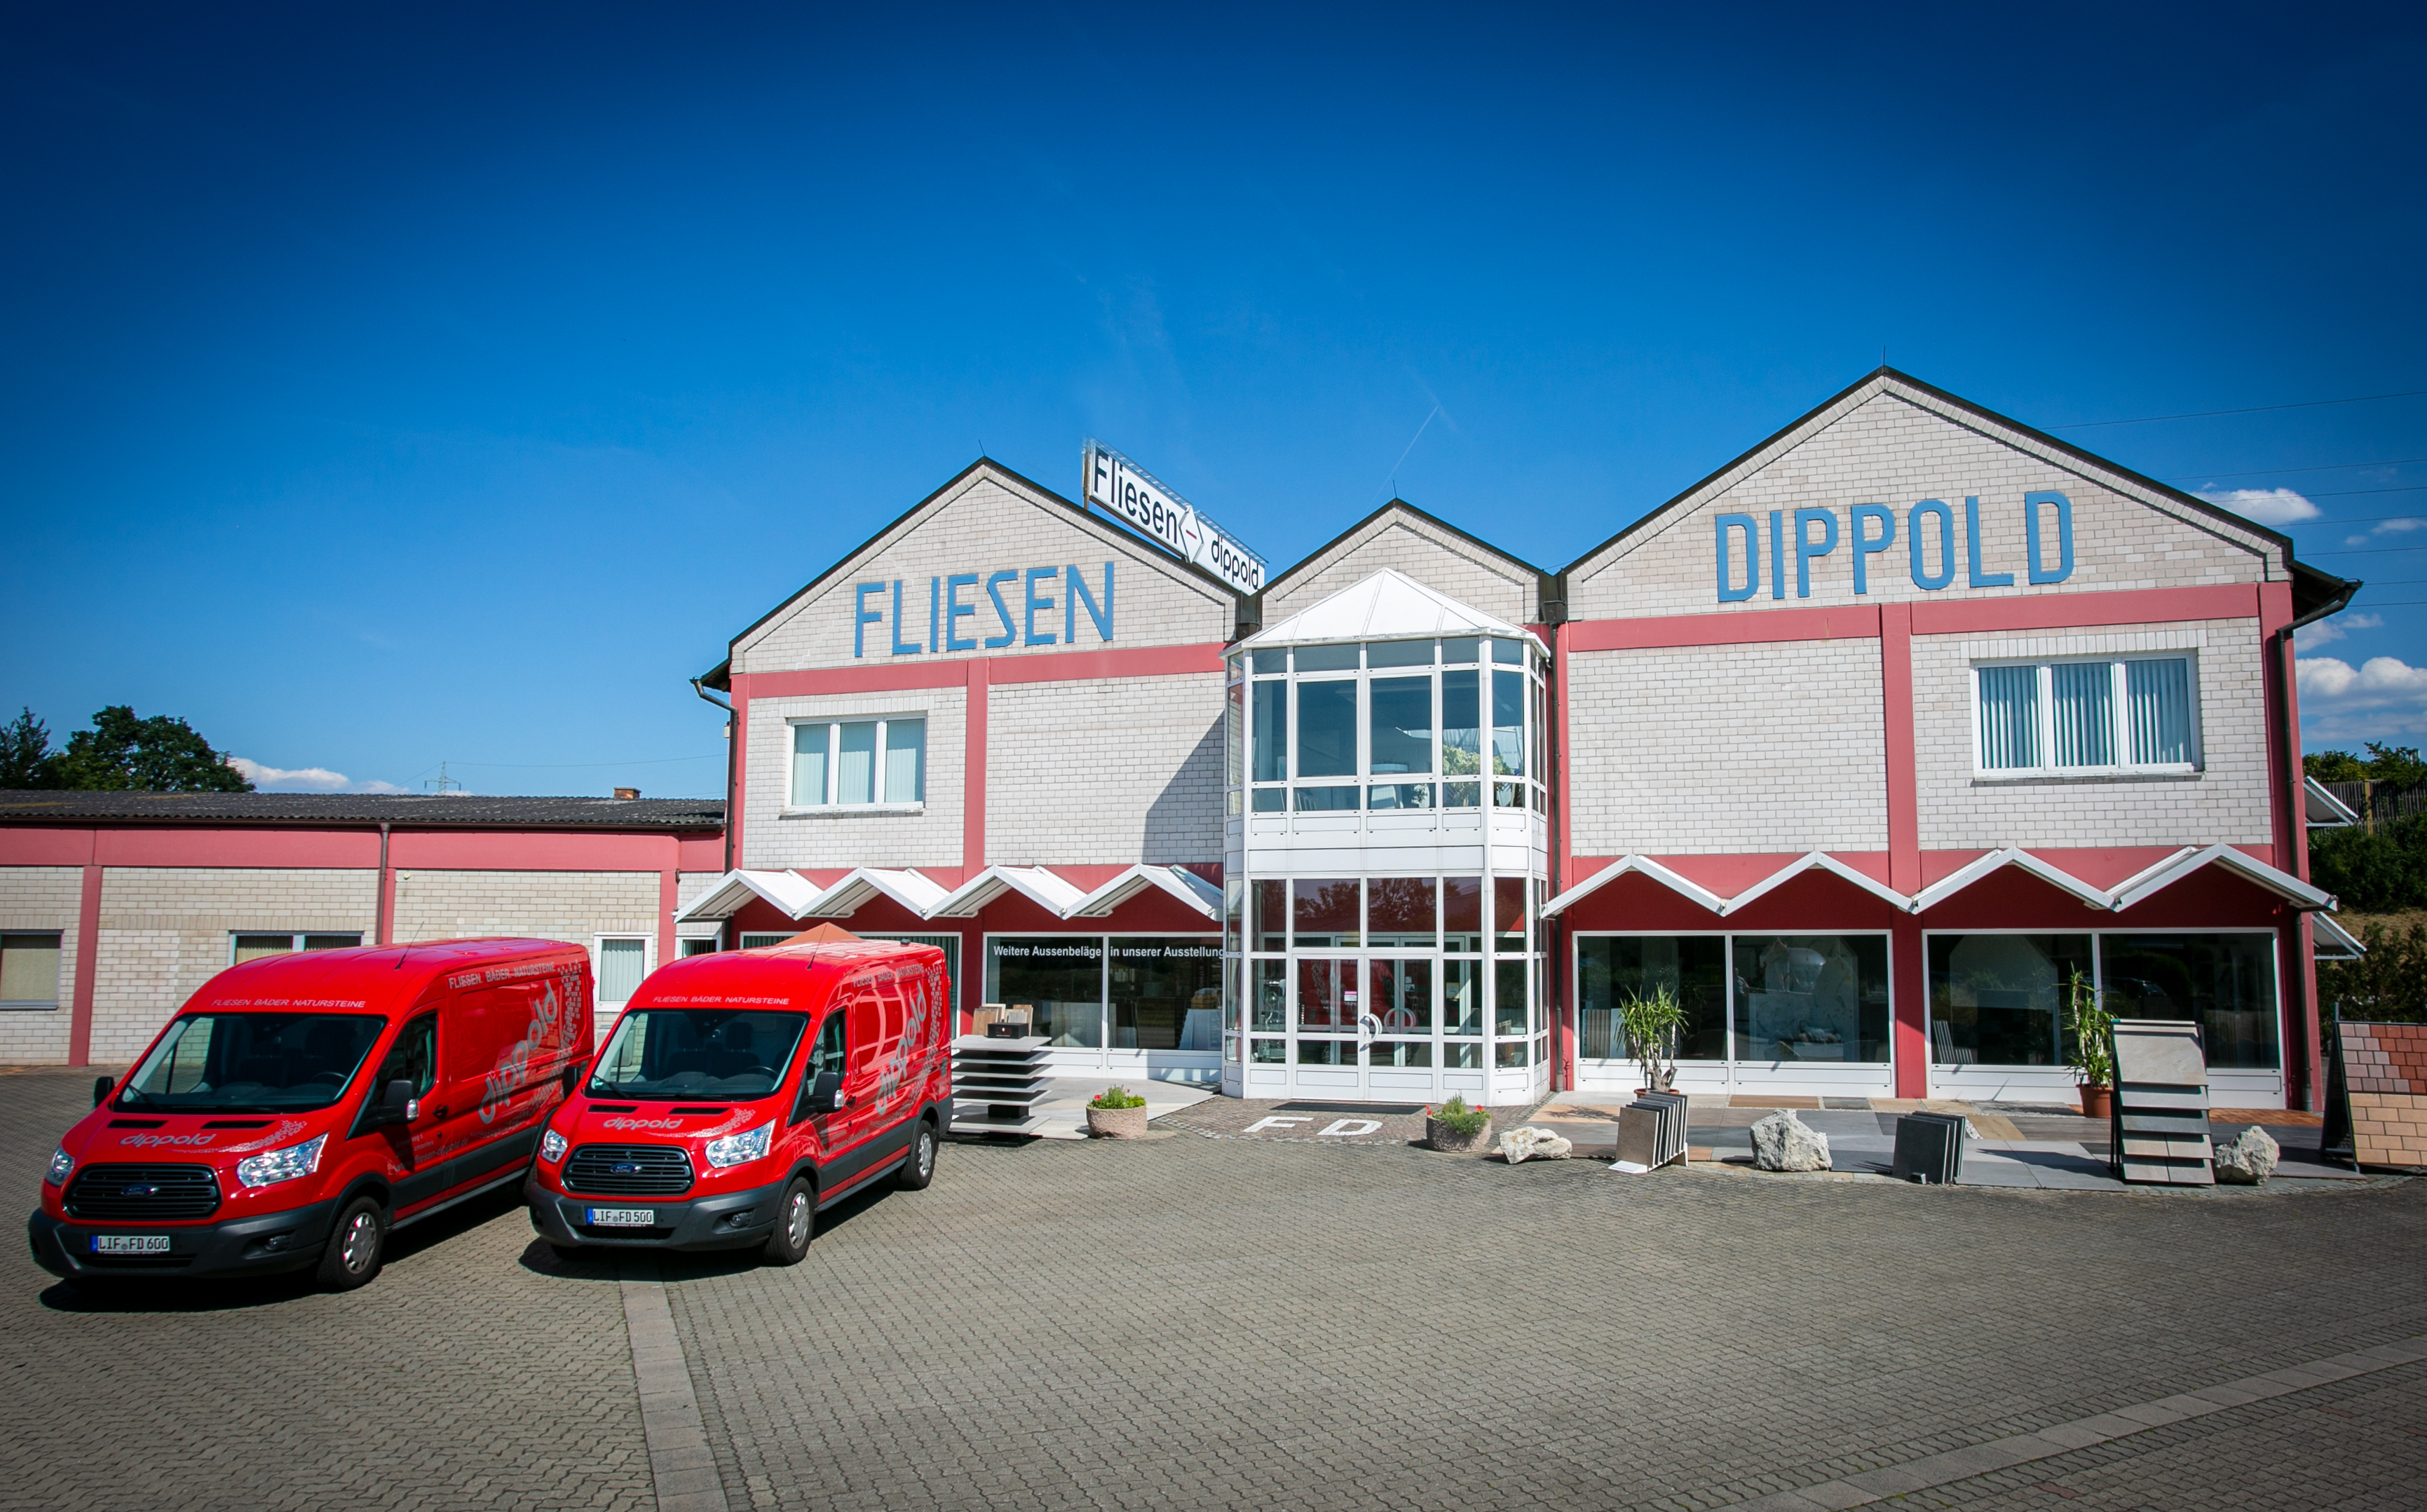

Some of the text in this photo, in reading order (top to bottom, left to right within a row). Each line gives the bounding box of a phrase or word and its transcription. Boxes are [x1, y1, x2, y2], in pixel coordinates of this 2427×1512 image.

[1094, 445, 1260, 590] Fliesen dippold
[1715, 490, 2074, 603] DIPPOLD
[854, 561, 1115, 658] FLIESEN
[993, 945, 1223, 960] Weitere Aussenbeläge in unserer Ausstellung
[513, 961, 555, 977] NATURSTEINE
[292, 999, 366, 1008] NATURSTEINE
[725, 996, 790, 1005] NATURSTEINE
[478, 979, 558, 1124] dippold
[875, 980, 927, 1116] dippold
[603, 1117, 684, 1131] dippold
[119, 1133, 217, 1148] dippold
[593, 1211, 652, 1222] LIF FD 500
[99, 1237, 169, 1250] LIF FD 600
